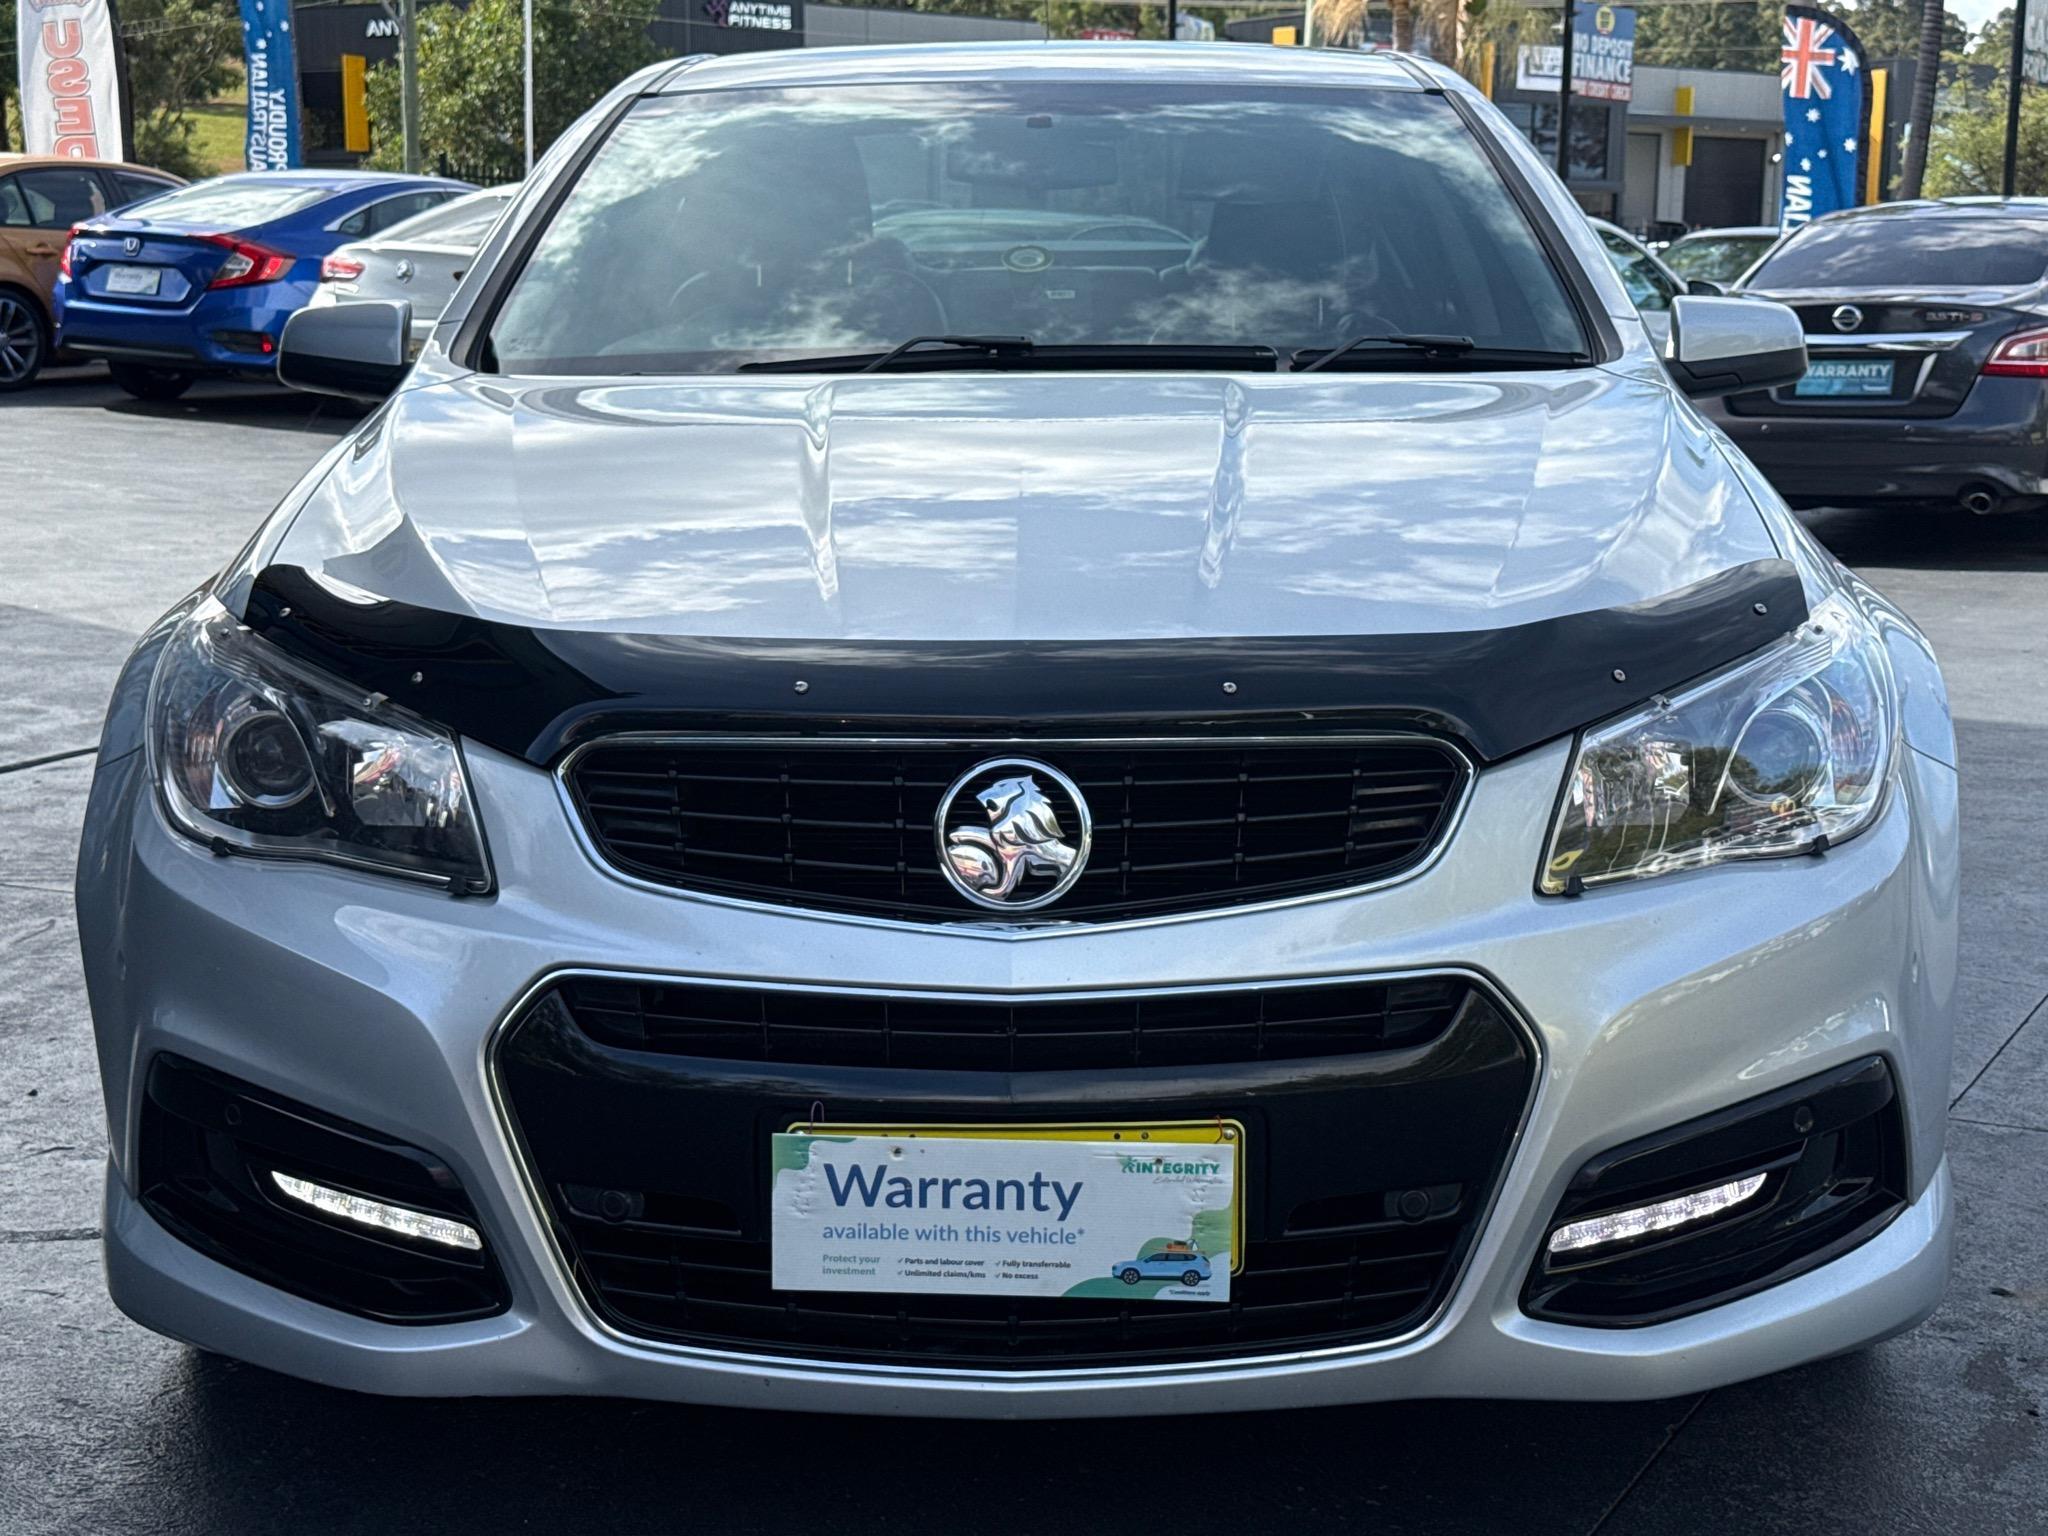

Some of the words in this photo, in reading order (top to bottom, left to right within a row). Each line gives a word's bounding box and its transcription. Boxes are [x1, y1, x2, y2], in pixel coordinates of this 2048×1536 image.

[729, 1, 791, 17] ANYTIME
[728, 14, 791, 30] FITNESS
[1591, 35, 1634, 60] DEPOSIT
[1572, 52, 1632, 83] FINANCE
[1136, 1162, 1221, 1175] INTEGRITY
[823, 1163, 1083, 1221] Warranty
[823, 1222, 910, 1240] available
[914, 1224, 959, 1242] with
[965, 1225, 1001, 1243] this
[822, 1254, 857, 1264] Protect
[858, 1256, 881, 1265] your
[904, 1257, 924, 1265] Parts
[940, 1258, 963, 1266] labour
[1002, 1260, 1021, 1268] Fully
[822, 1266, 876, 1276] investment
[904, 1269, 941, 1277] Unlimited
[943, 1270, 986, 1279] claims/kms
